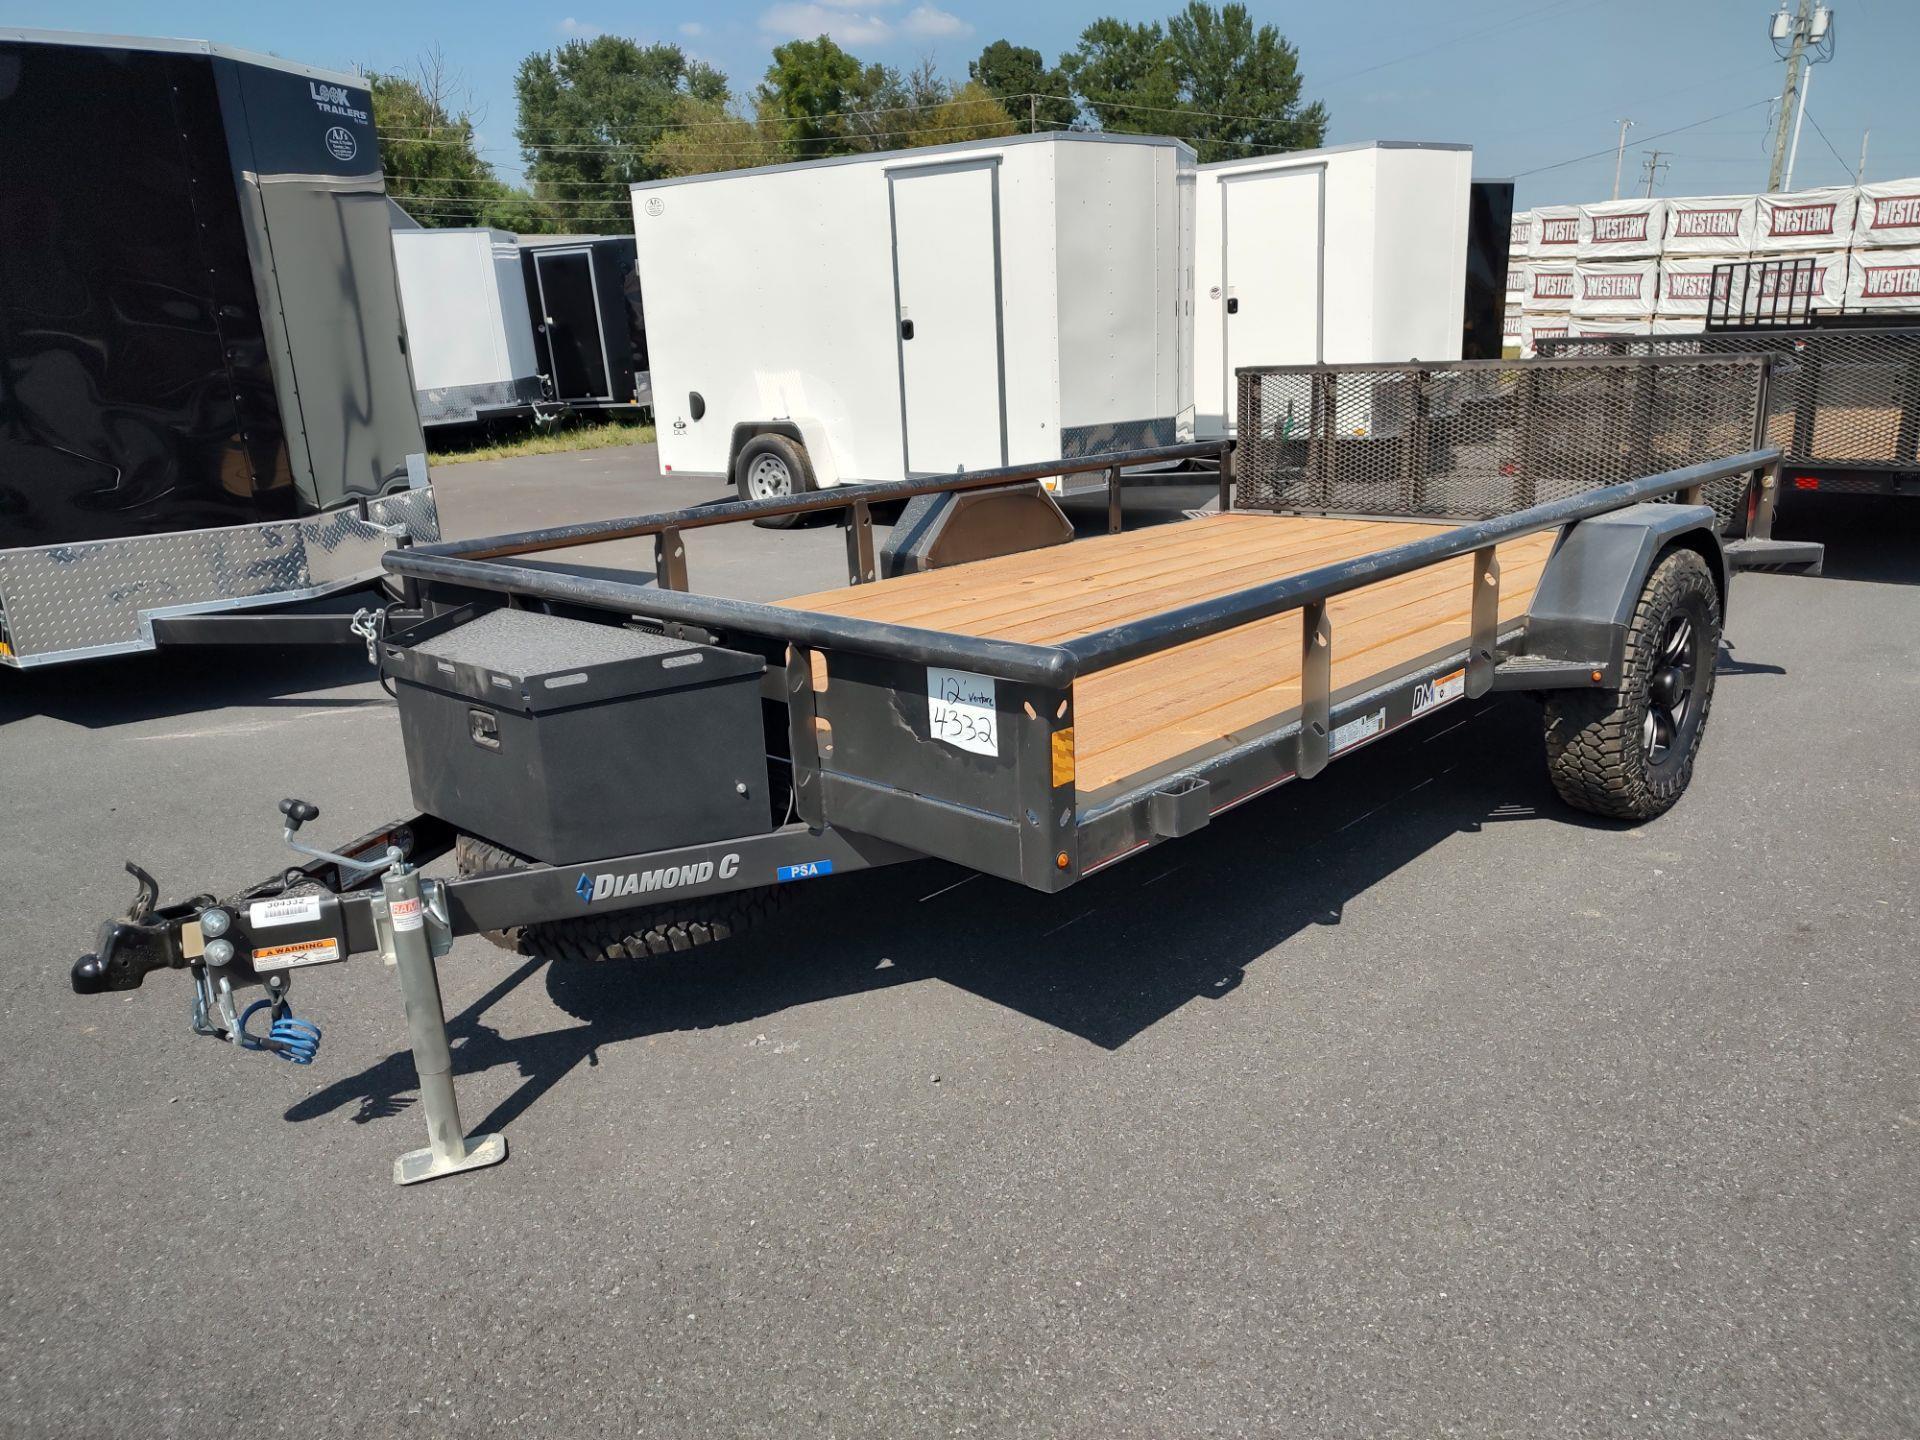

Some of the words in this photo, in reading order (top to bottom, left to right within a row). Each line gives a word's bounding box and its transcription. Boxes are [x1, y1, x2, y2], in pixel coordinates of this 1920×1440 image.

[309, 81, 350, 107] LOOK
[317, 102, 367, 120] TRAILERS
[1680, 212, 1735, 234] WESTERN
[1774, 206, 1832, 233] WESTERN
[1877, 200, 1920, 225] WESTE
[1596, 217, 1646, 240] WESTERN
[1537, 275, 1573, 296] WESTER
[1587, 276, 1638, 296] WESTERN
[1868, 269, 1920, 294] WESTER
[934, 707, 997, 748] 4332
[592, 861, 714, 901] DIAMOND
[718, 853, 740, 880] C
[791, 862, 819, 878] PSA
[276, 942, 324, 954] WARNING
